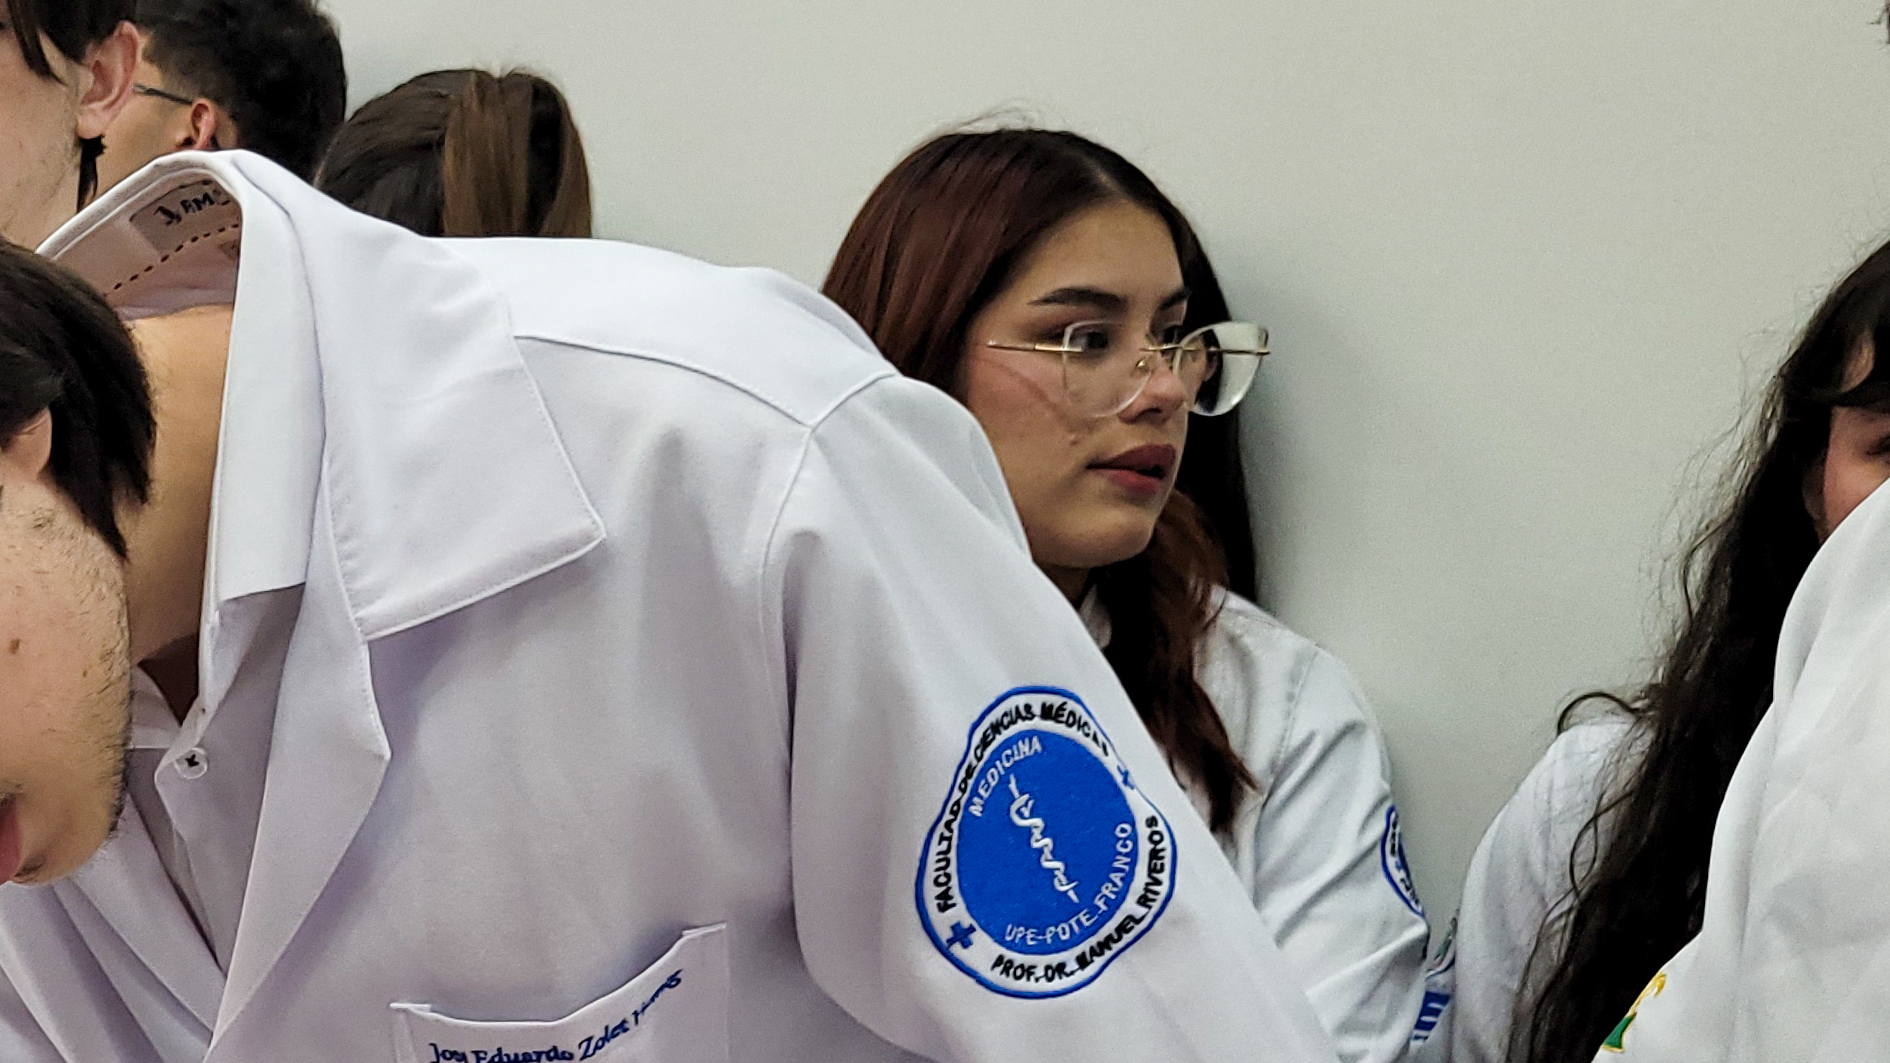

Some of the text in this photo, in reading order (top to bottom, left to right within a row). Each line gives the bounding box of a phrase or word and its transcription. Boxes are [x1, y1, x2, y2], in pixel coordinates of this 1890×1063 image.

[932, 793, 963, 914] FACULTAD
[958, 761, 976, 794] DE
[973, 702, 1036, 761] CIENCIAS
[969, 735, 1043, 818] MEDICINA
[1074, 912, 1145, 975] MANUEL
[1136, 815, 1167, 909] RIVEROS
[1096, 822, 1134, 912] FRANCO
